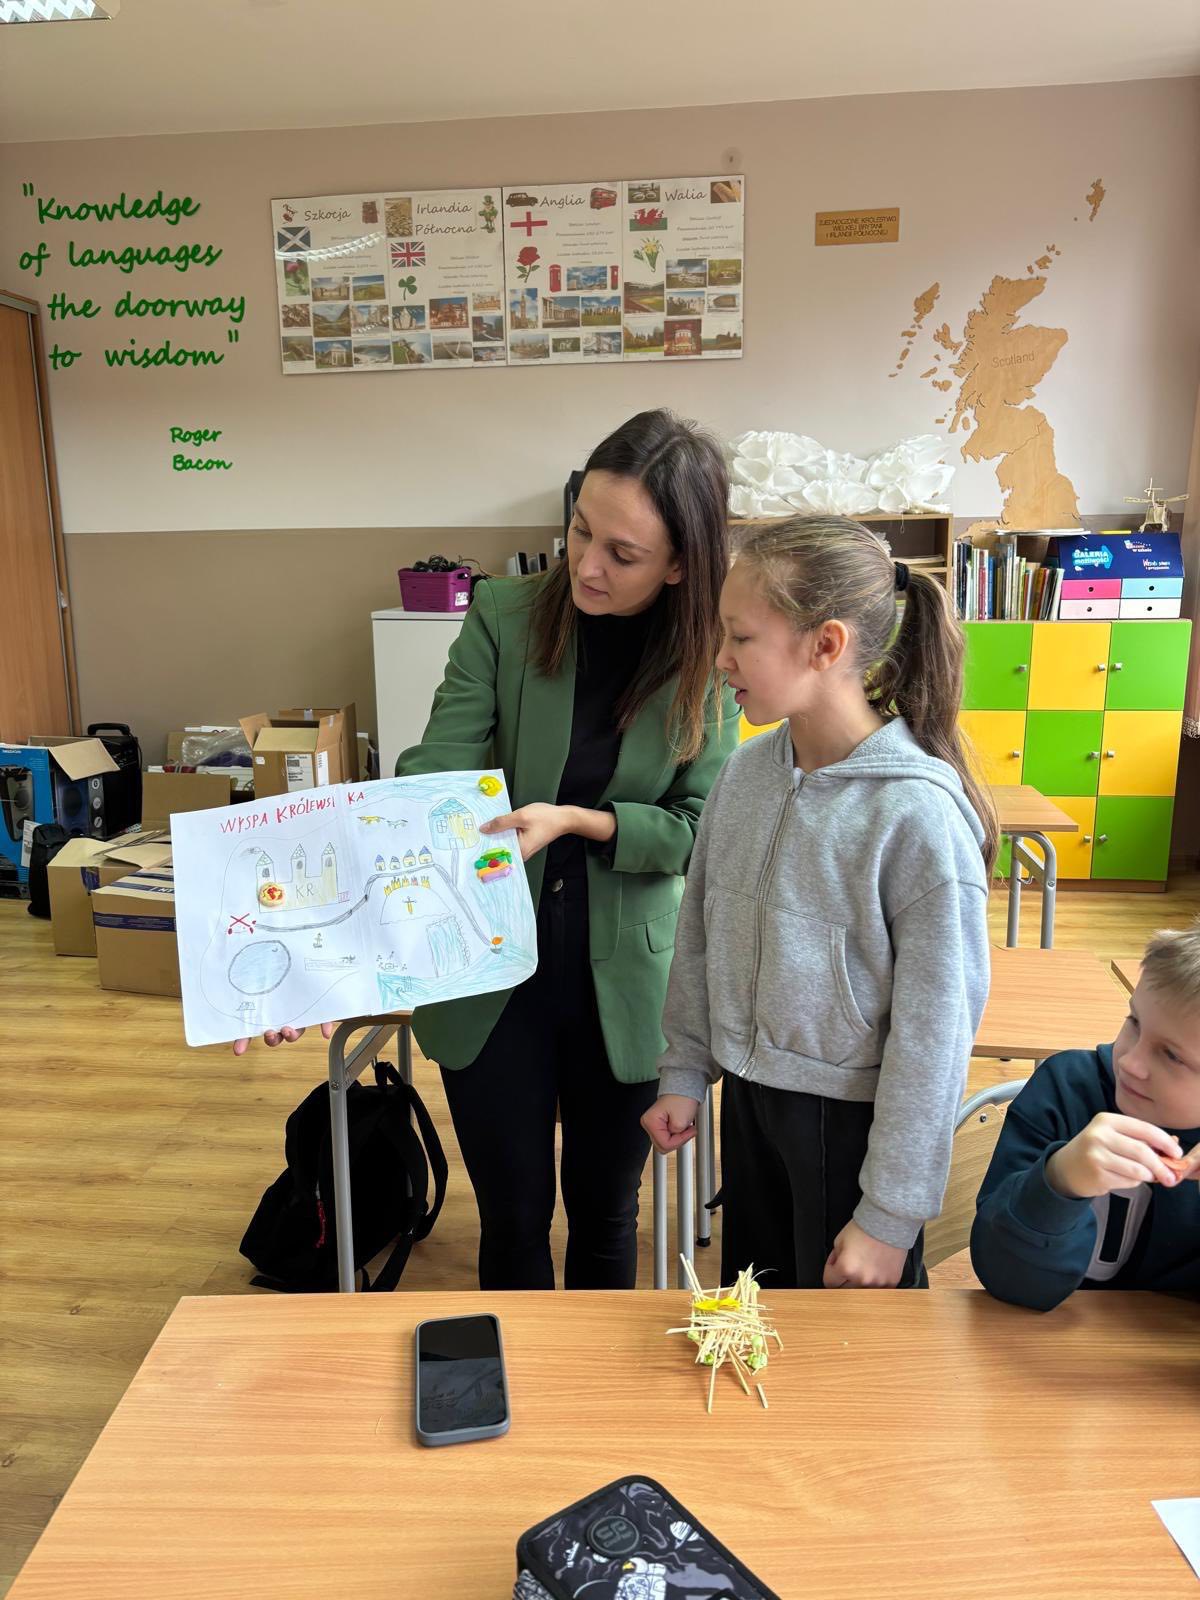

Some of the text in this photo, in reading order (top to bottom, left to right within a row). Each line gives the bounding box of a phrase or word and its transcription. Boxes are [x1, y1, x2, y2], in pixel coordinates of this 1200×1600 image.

[22, 182, 200, 225] "Knowledge
[539, 195, 586, 208] Anglia
[665, 189, 707, 201] Walia
[304, 208, 352, 222] Szkocja
[416, 202, 472, 214] Irlandia
[415, 224, 476, 235] Północna
[19, 240, 223, 277] of languages
[47, 292, 246, 324] the doorway
[48, 344, 82, 370] to
[991, 350, 1035, 368] Scotland
[169, 426, 222, 446] Roger
[172, 454, 233, 471] Bacon
[220, 812, 269, 834] WYSPA
